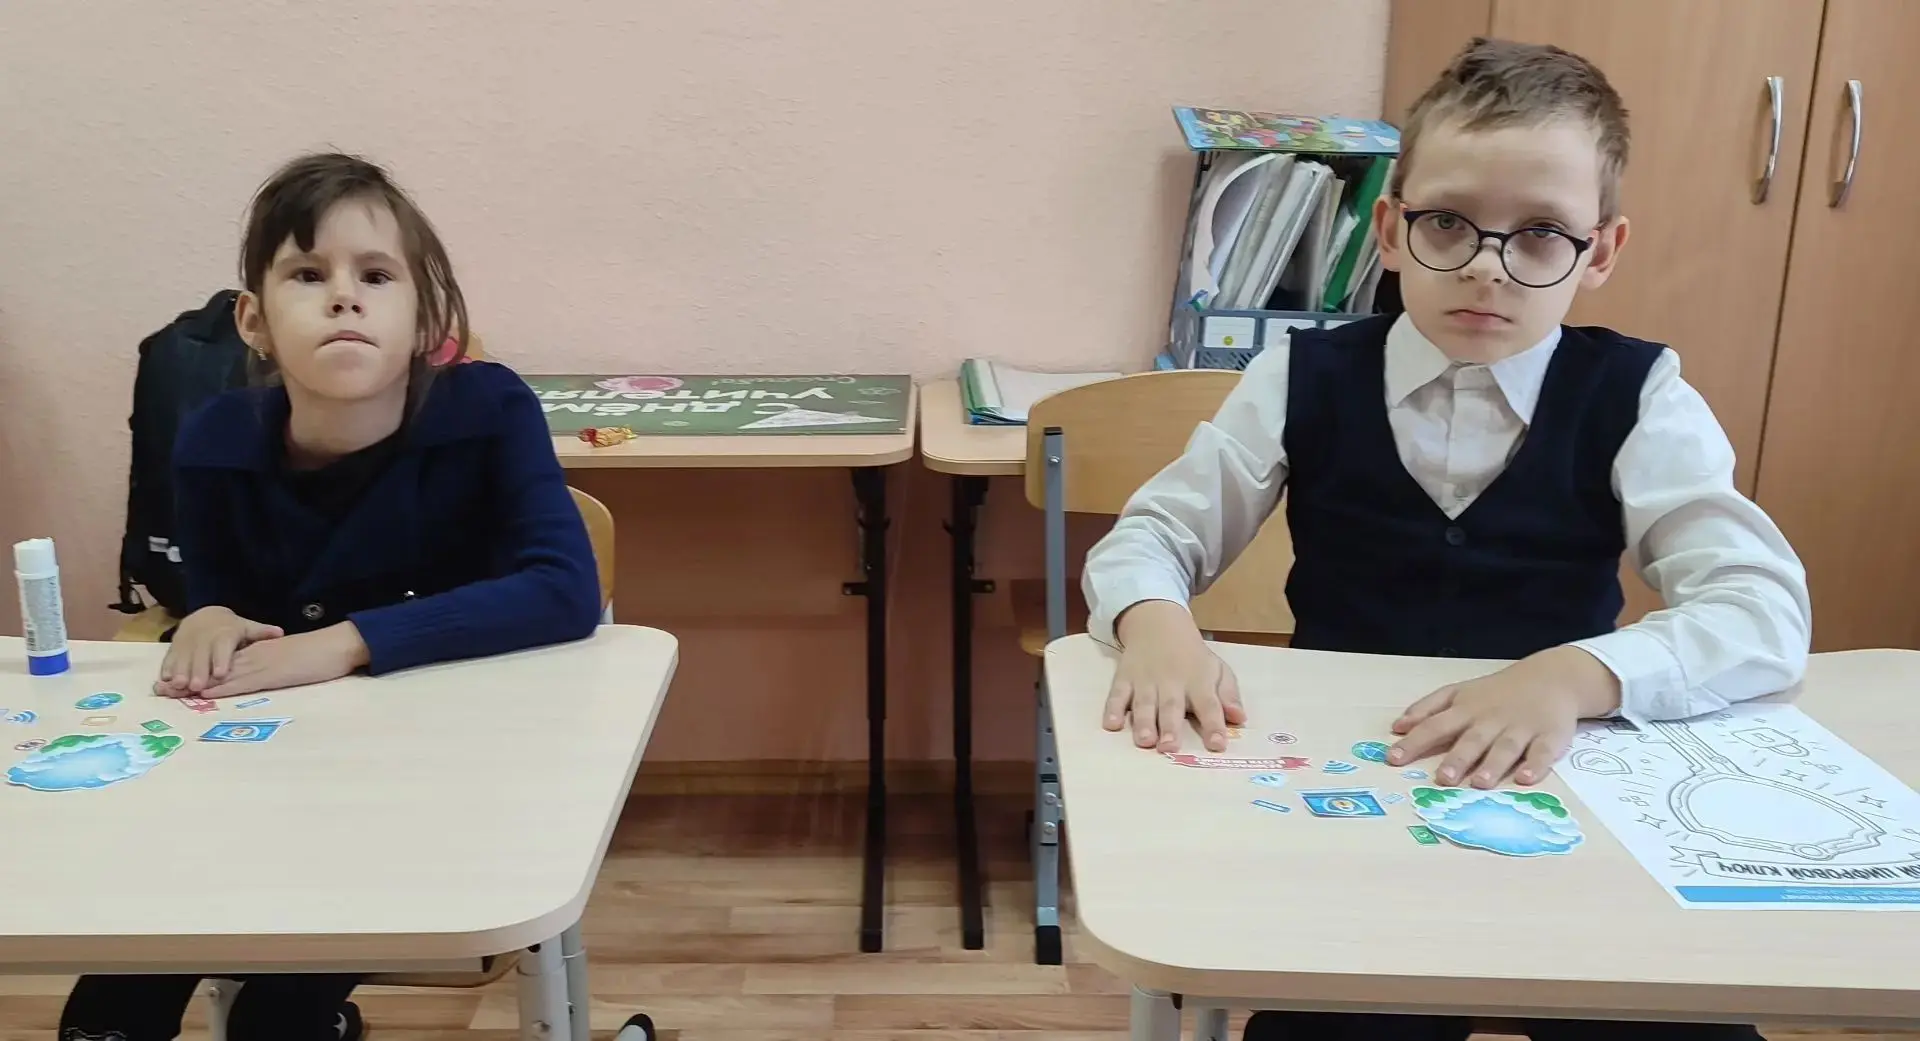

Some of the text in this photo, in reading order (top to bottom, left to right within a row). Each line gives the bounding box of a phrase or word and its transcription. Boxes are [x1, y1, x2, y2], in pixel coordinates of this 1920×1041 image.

[1718, 862, 1920, 880] ОЙ ЦИФРОВОЙ КЛЮЧ
